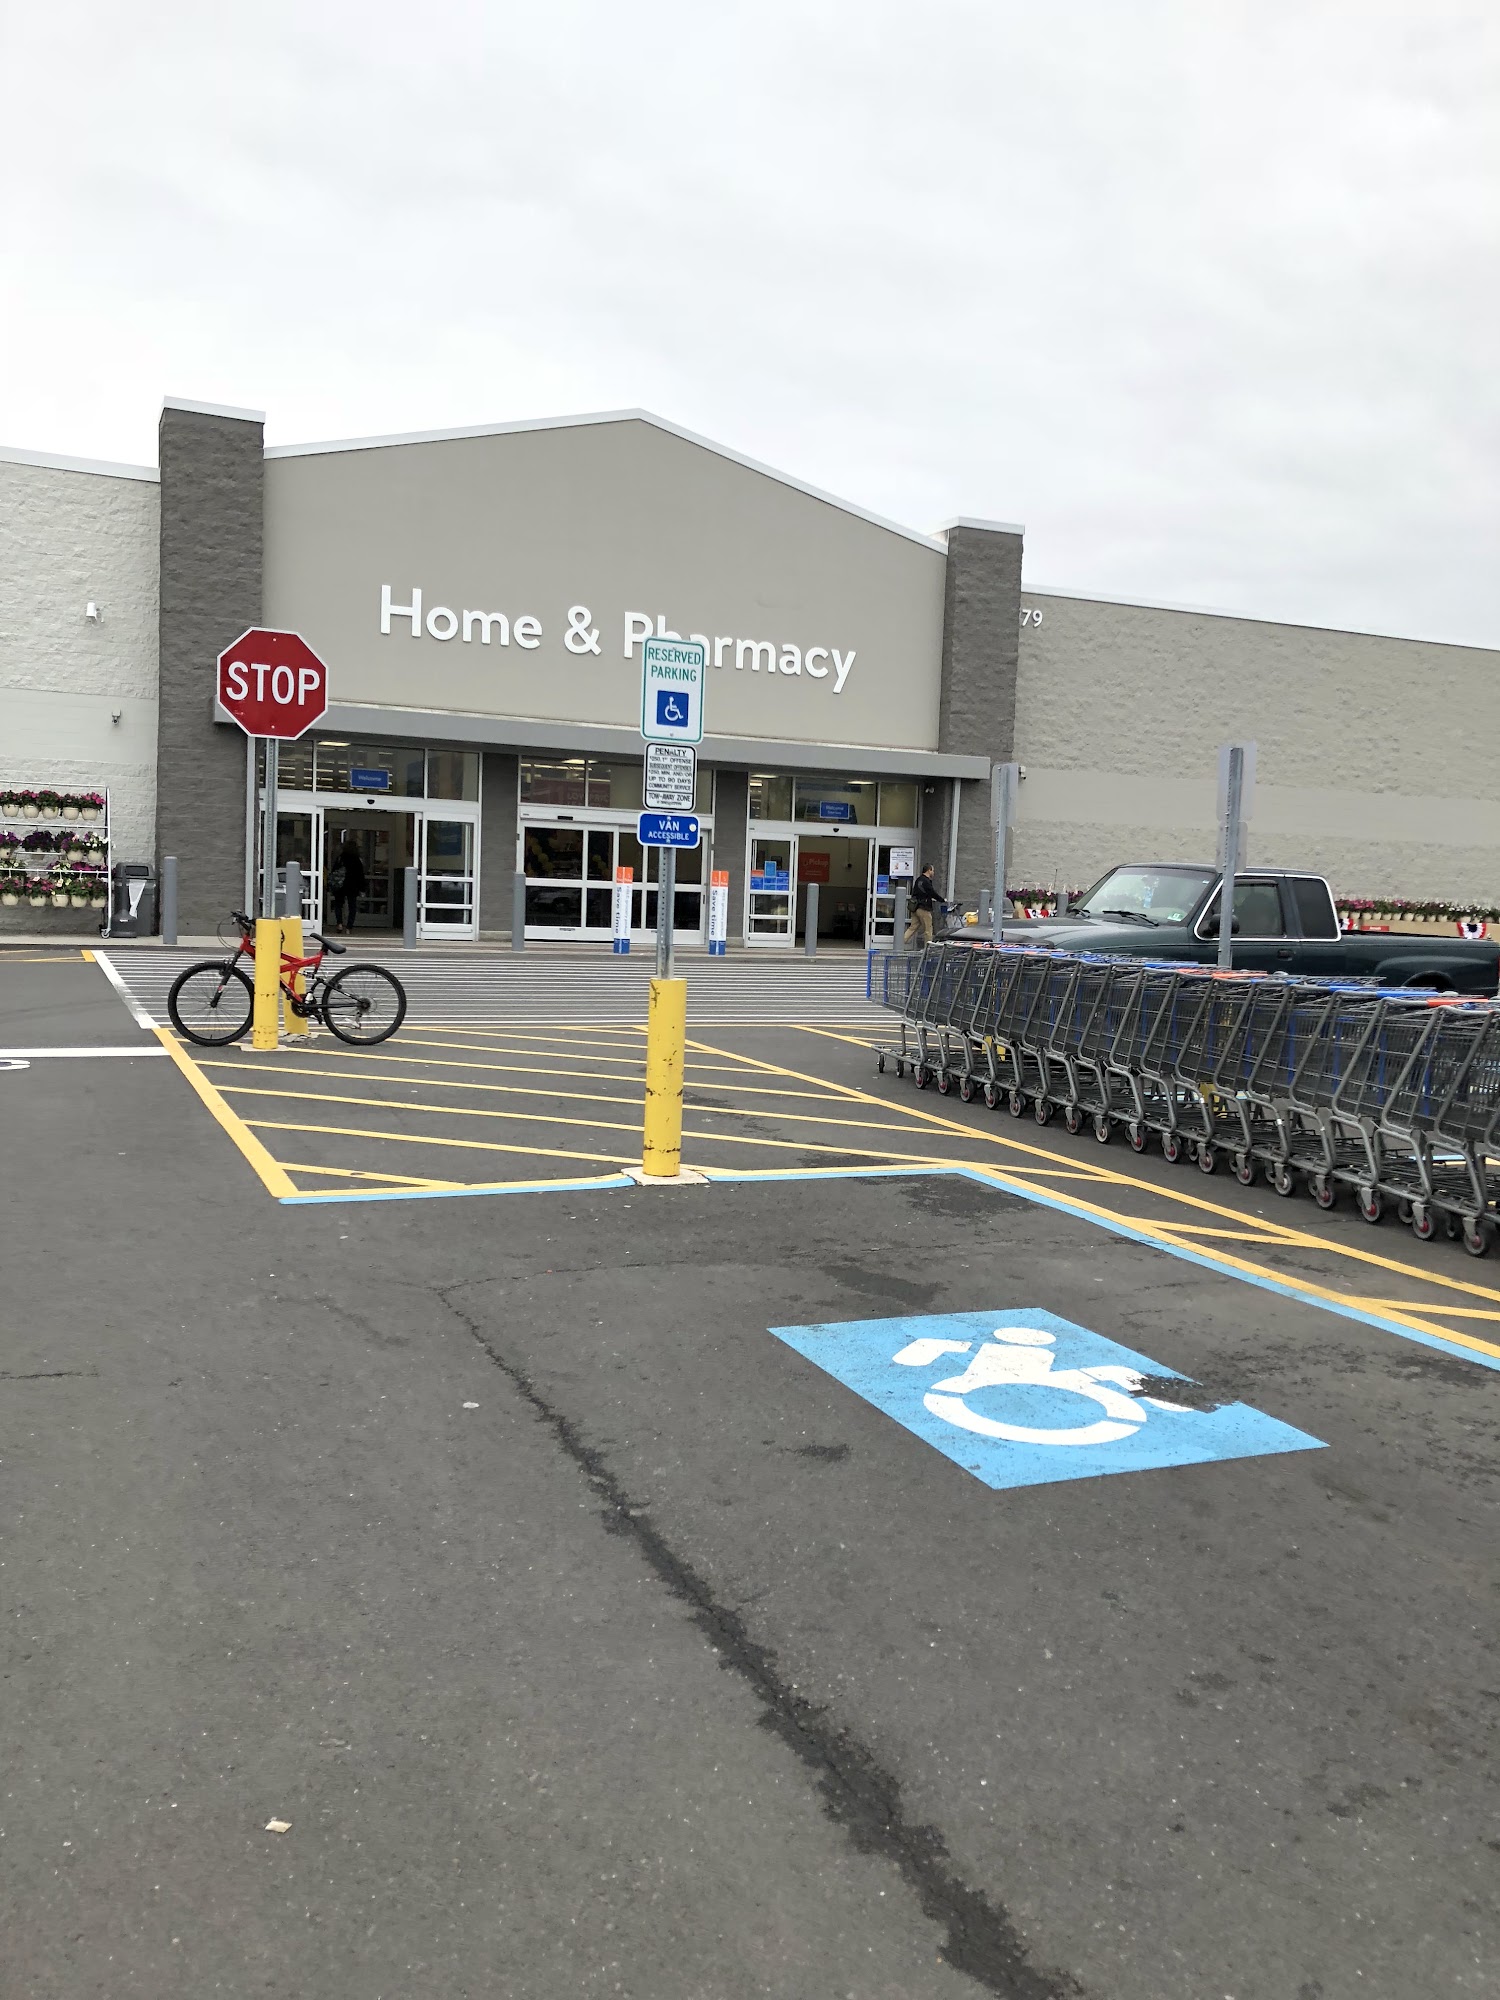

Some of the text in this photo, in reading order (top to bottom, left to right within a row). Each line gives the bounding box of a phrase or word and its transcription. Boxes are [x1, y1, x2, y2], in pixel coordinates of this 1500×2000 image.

[380, 584, 543, 650] Home
[564, 605, 602, 657] &
[648, 646, 701, 666] RESERVED
[650, 664, 698, 683] PARKING
[226, 660, 321, 707] STOP
[655, 747, 687, 757] PENALTY
[648, 792, 691, 802] TOW-AWAY ZONE
[658, 820, 680, 832] VAN
[648, 830, 690, 841] ACCESSIBLE
